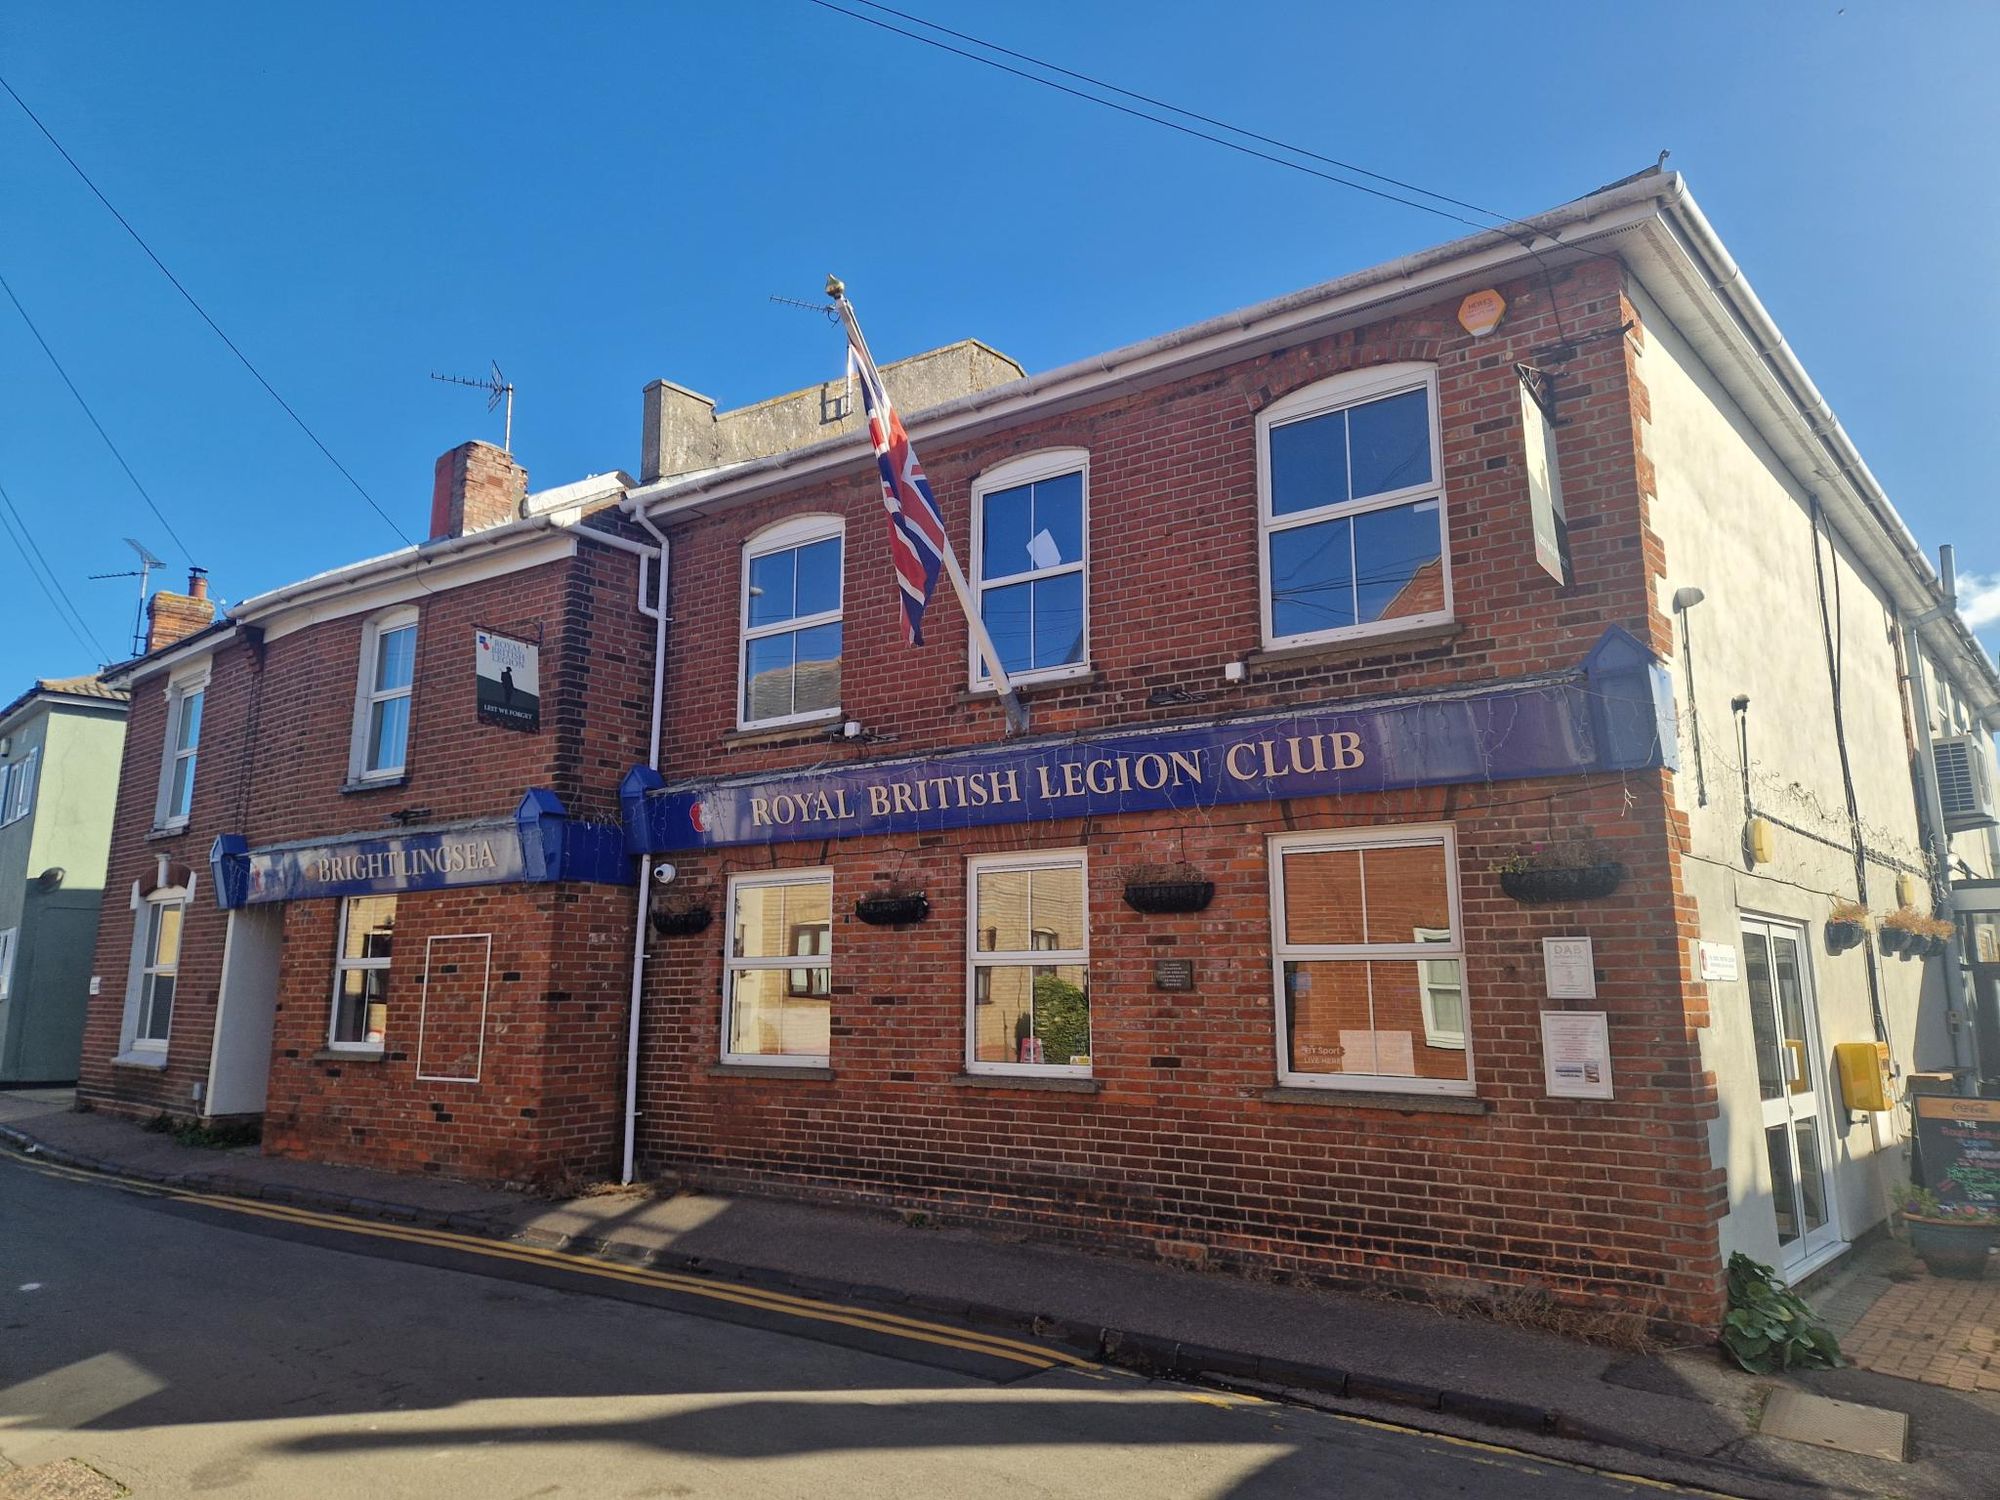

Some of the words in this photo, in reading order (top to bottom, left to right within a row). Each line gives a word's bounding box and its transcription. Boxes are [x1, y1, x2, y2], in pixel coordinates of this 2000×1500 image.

[750, 789, 855, 827] ROYAL
[867, 770, 1021, 817] BRITISH
[1037, 748, 1203, 800] LEGION
[1226, 731, 1366, 782] CLUB
[318, 840, 497, 883] BRIGHTLINGSEA
[1318, 1046, 1340, 1055] Sport
